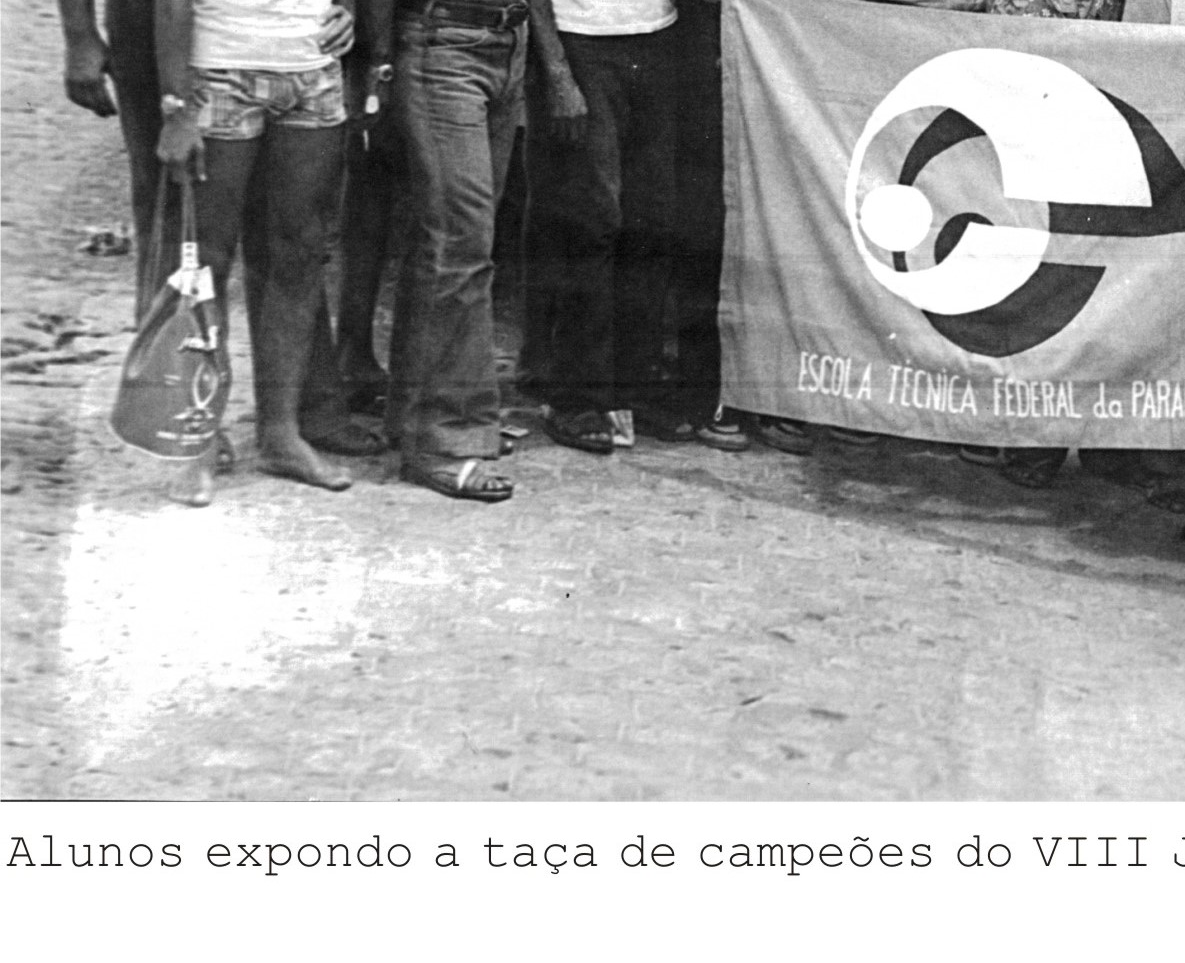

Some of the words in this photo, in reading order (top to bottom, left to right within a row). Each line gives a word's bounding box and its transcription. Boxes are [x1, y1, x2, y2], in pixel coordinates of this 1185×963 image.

[798, 351, 872, 400] ESCOLA
[992, 377, 1083, 418] FEDERAL
[1092, 381, 1123, 418] da
